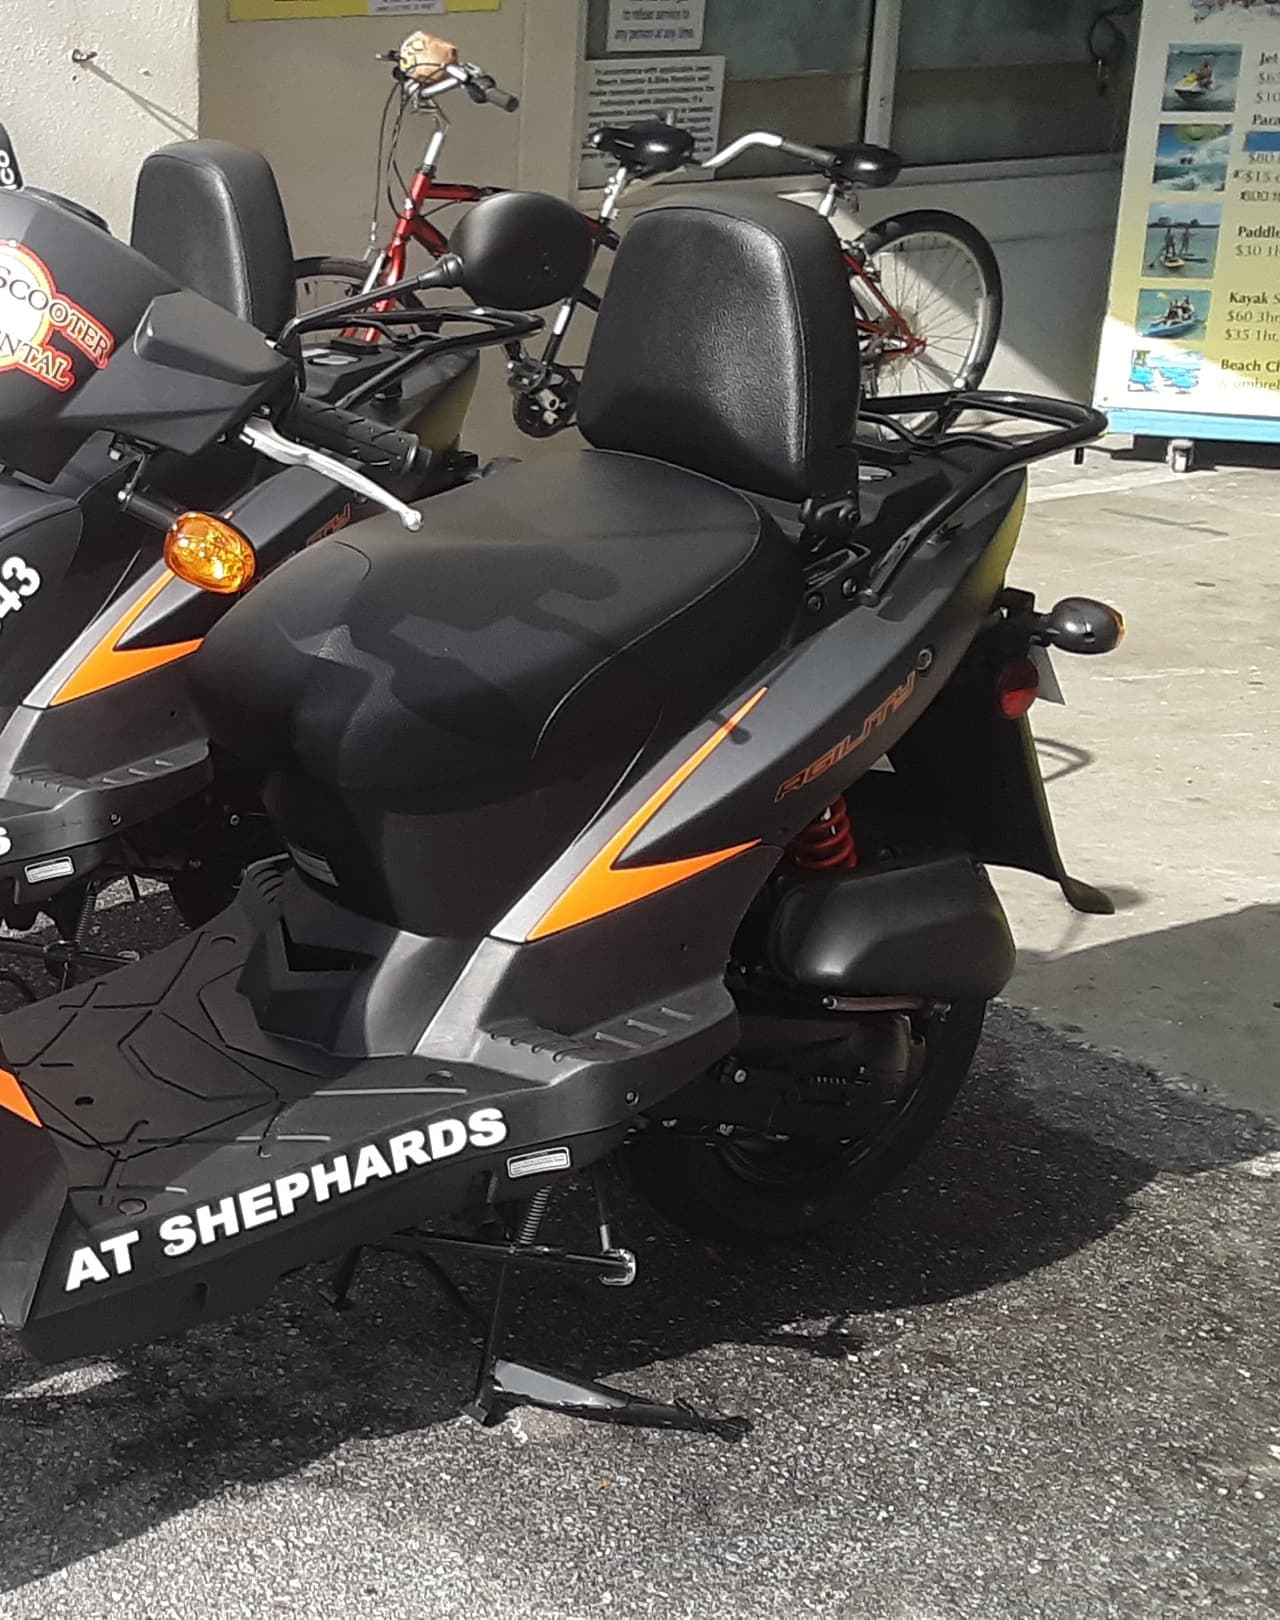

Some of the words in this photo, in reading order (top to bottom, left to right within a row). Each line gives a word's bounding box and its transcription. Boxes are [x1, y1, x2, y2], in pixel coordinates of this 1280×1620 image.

[1259, 52, 1278, 66] Jet
[1229, 291, 1268, 307] Kayak
[1226, 311, 1253, 323] $60
[1224, 328, 1250, 341] $35
[1220, 359, 1261, 372] Beach
[64, 1231, 140, 1292] AT
[159, 1107, 509, 1258] SHEPHARDS
